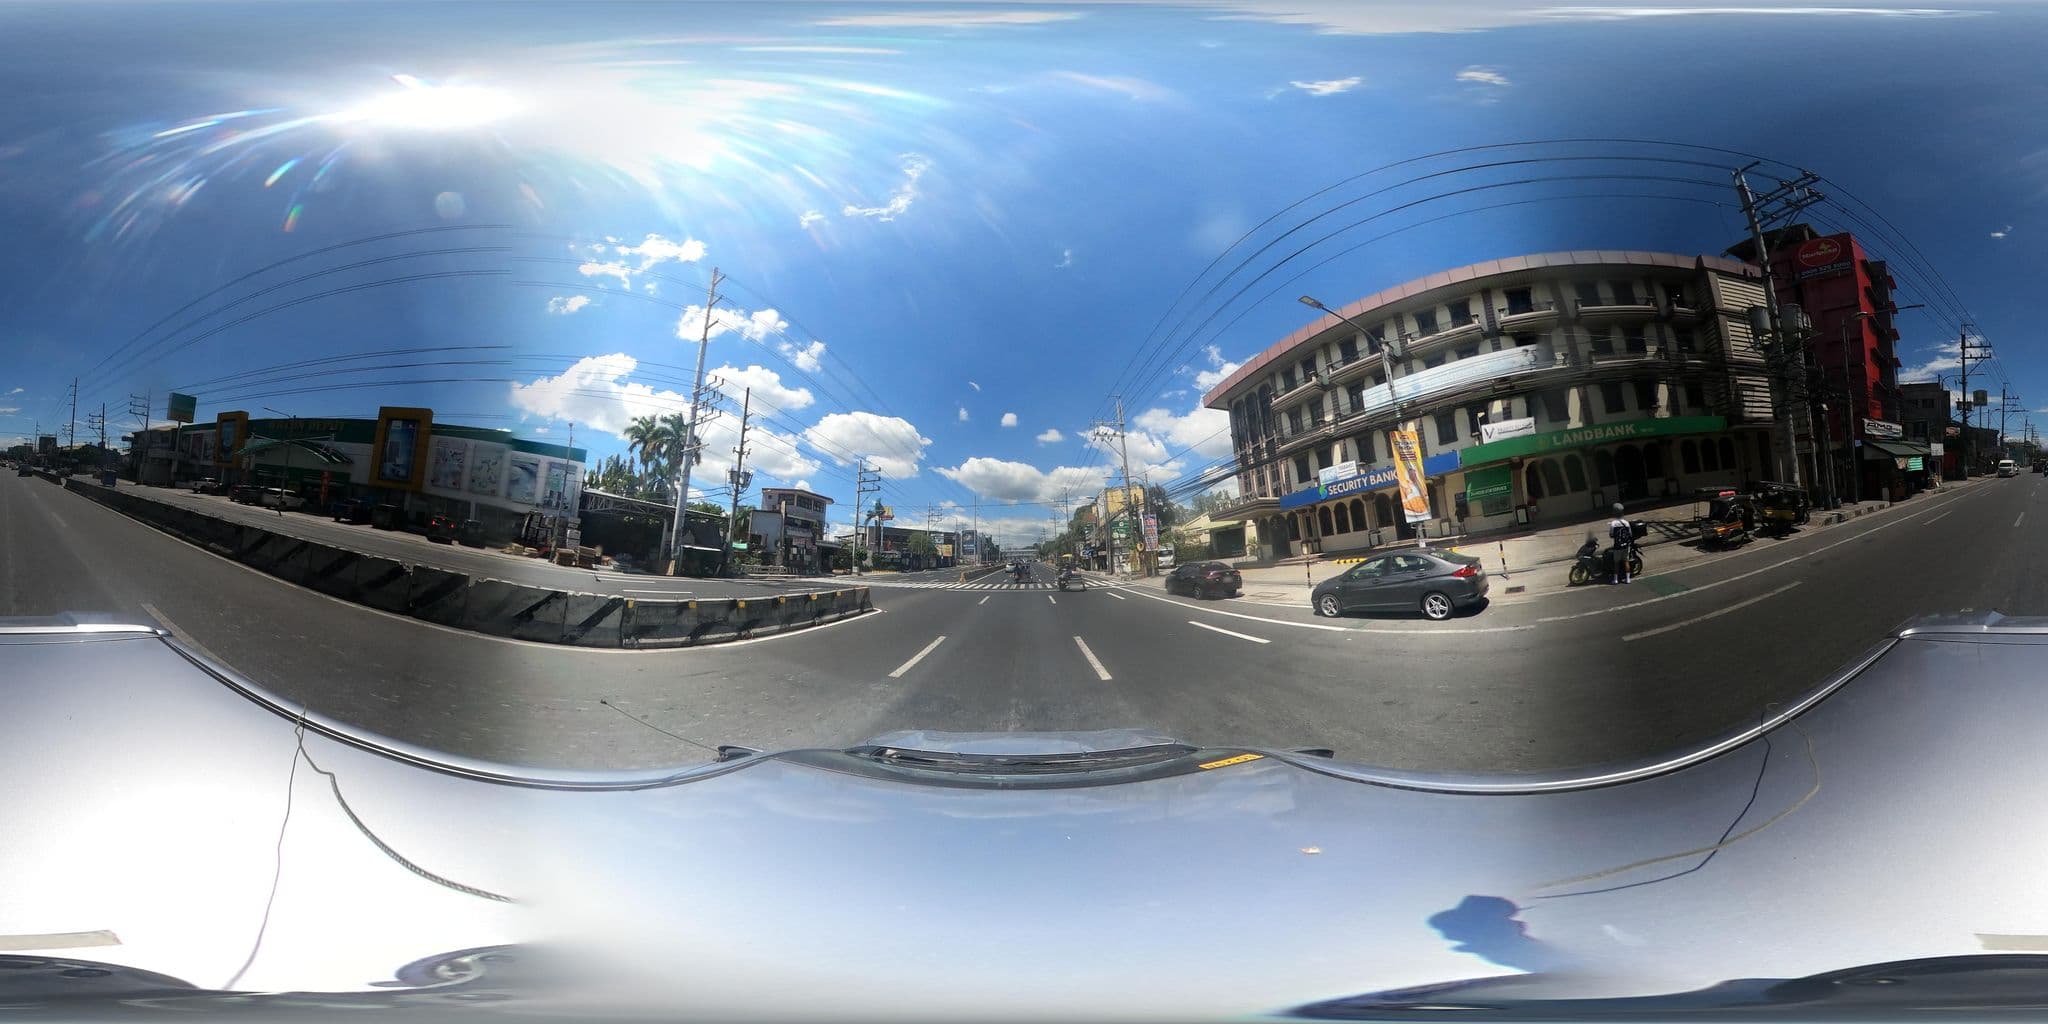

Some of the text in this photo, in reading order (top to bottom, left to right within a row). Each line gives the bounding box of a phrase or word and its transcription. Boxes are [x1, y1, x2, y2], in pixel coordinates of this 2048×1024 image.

[1552, 424, 1636, 445] LANDBANK
[1328, 477, 1368, 495] SECURITY
[1369, 470, 1398, 485] BANK
